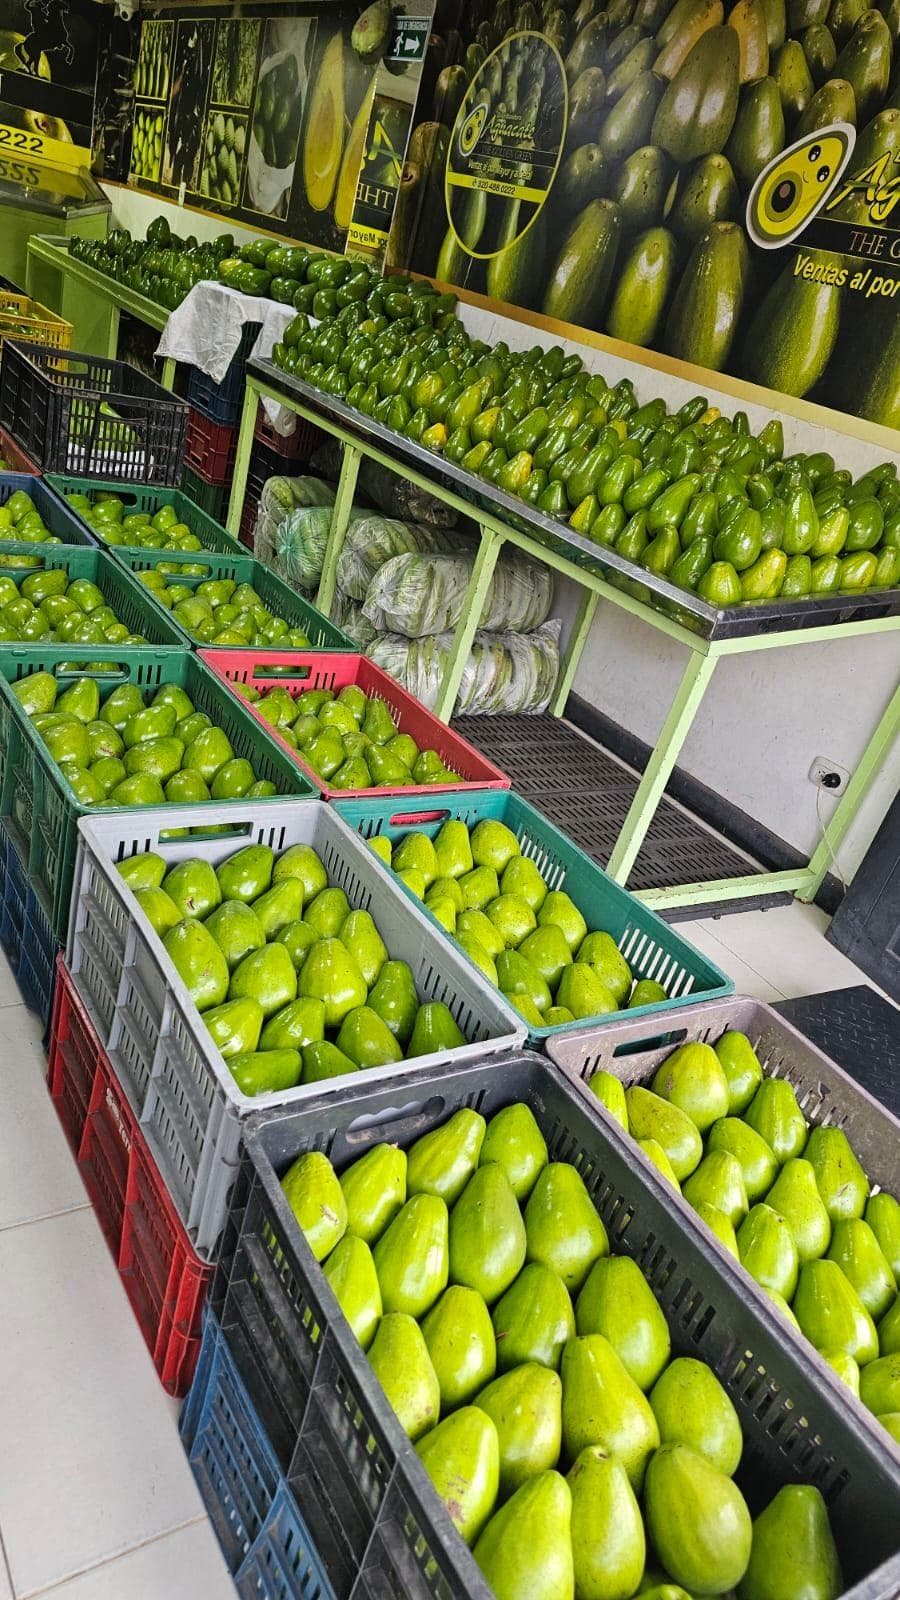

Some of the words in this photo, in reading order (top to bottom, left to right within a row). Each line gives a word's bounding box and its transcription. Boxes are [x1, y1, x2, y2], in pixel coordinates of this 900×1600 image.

[0, 128, 43, 154] 222
[850, 230, 887, 256] THE
[793, 254, 849, 288] Ventas
[850, 268, 873, 290] al
[865, 273, 900, 298] por
